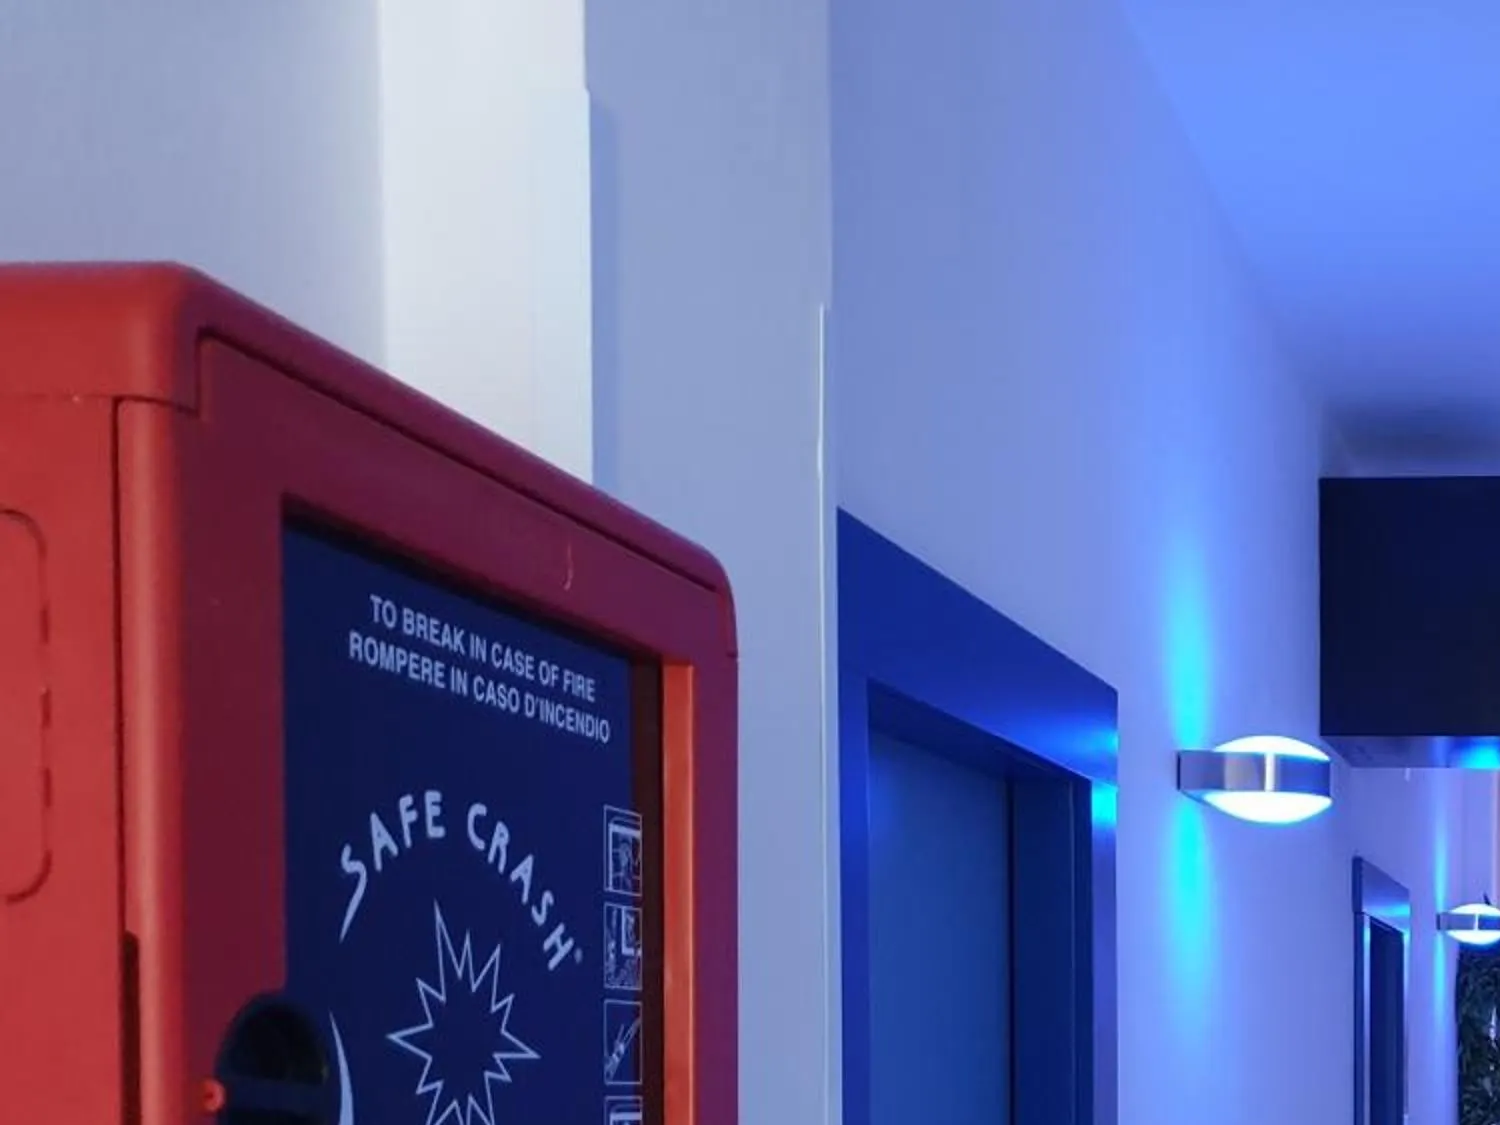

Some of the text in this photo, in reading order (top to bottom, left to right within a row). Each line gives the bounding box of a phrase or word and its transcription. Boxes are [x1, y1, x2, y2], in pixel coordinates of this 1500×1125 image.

[349, 630, 610, 743] ROMPERE IN CASO D'INCENDIO
[370, 593, 596, 703] TO BREAK IN CASE OF FIRE
[339, 790, 574, 971] SAFE CRASH
